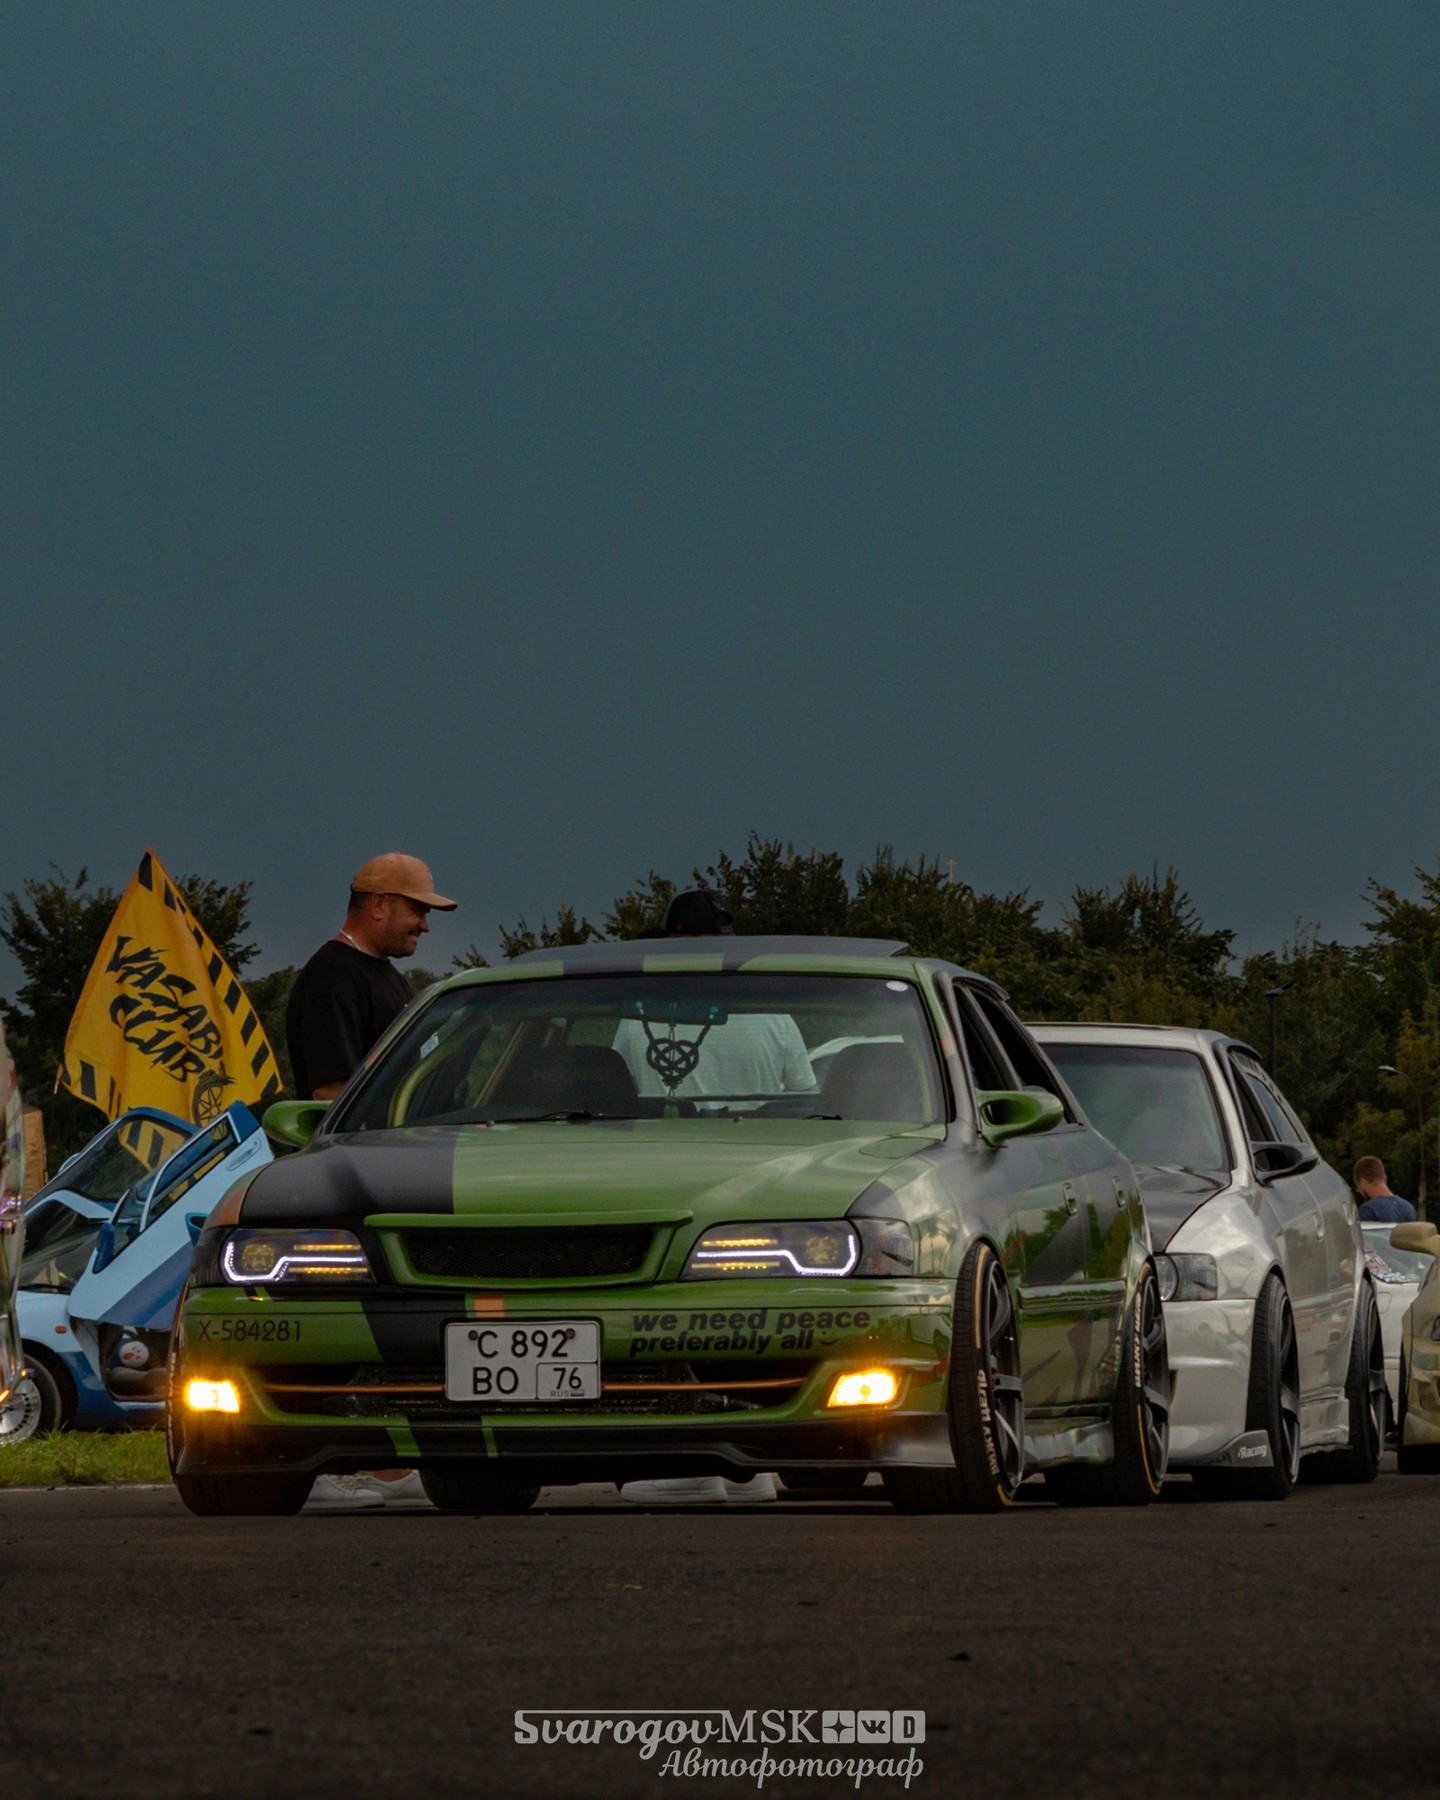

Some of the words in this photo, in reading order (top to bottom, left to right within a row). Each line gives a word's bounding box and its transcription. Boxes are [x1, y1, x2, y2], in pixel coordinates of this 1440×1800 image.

[109, 993, 206, 1082] CLUB
[198, 1320, 301, 1342] X-584281
[632, 1314, 678, 1332] we
[688, 1308, 768, 1331] need
[776, 1310, 870, 1335] peace
[511, 1329, 568, 1358] 892
[629, 1330, 772, 1357] preferably
[779, 1330, 814, 1350] all
[553, 1367, 582, 1390] 76
[551, 1390, 570, 1398] RUS
